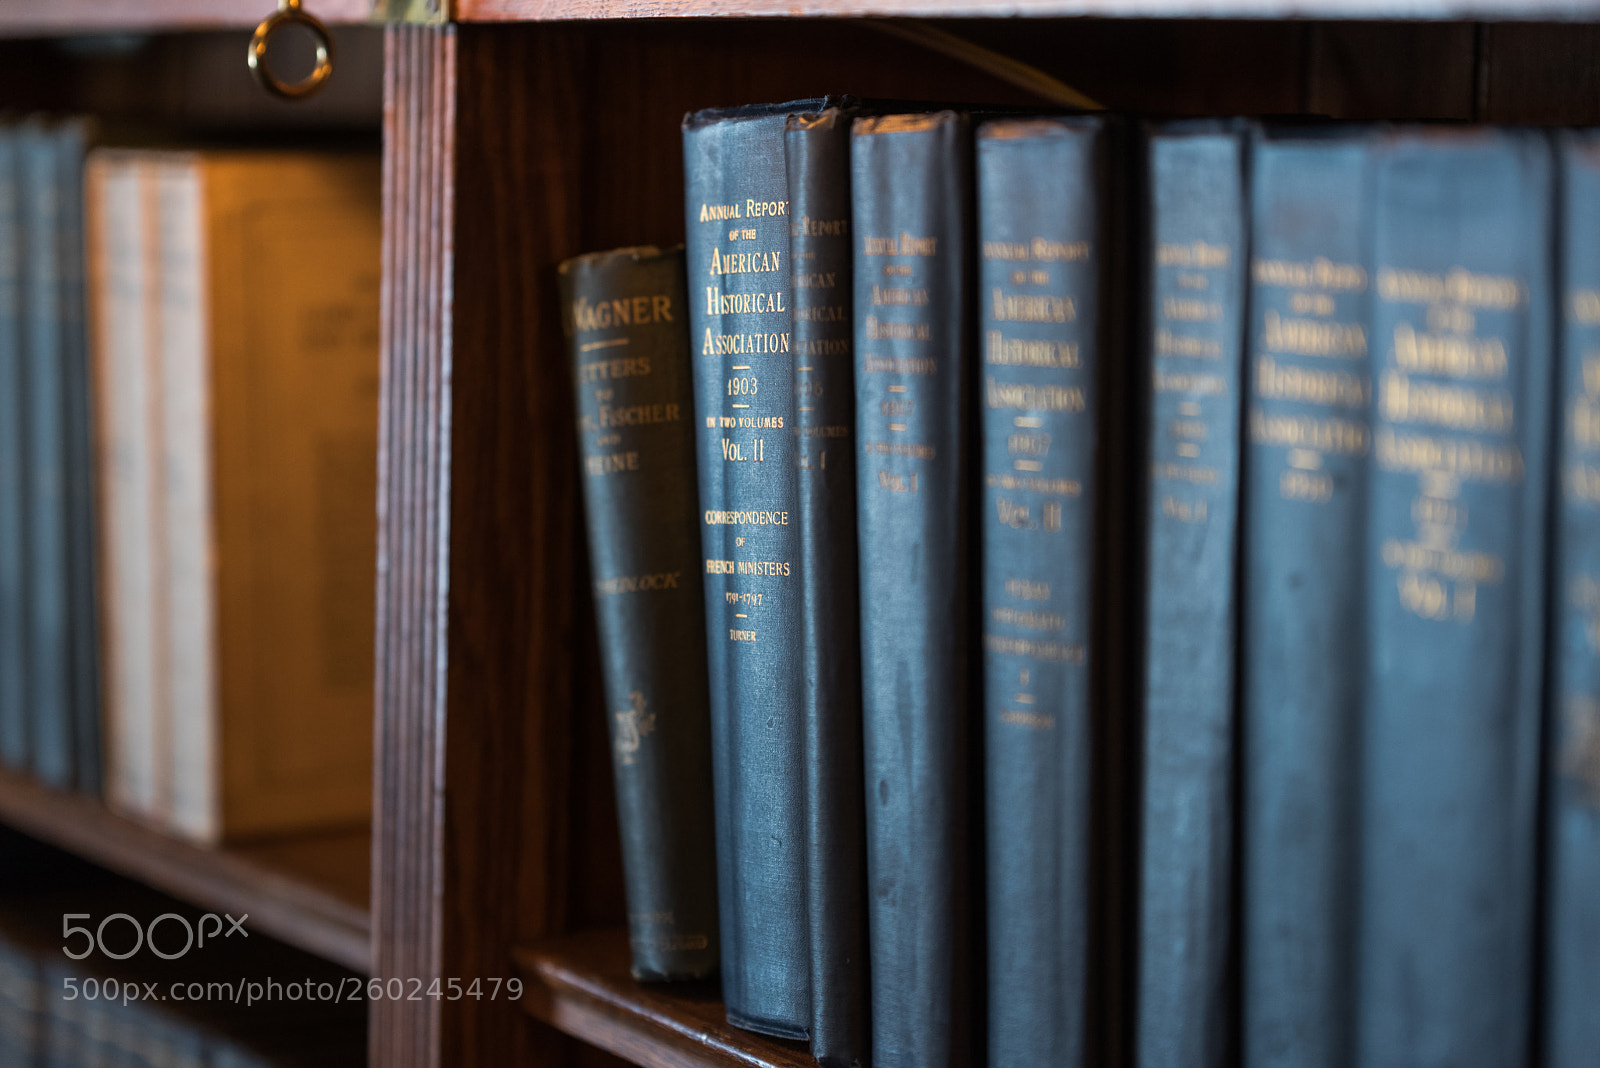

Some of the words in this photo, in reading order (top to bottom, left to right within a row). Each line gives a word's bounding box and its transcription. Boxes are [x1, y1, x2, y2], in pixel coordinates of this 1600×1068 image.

[699, 203, 741, 223] ANNUAL
[728, 230, 739, 242] OF
[741, 228, 757, 241] THE
[709, 247, 781, 276] AMERICAN
[706, 286, 786, 316] HISTORICAL
[702, 327, 790, 356] ASSOCIATION
[727, 377, 758, 396] 1903
[706, 416, 716, 429] IN
[719, 417, 737, 429] TWO
[738, 416, 784, 429] VOLUMES
[753, 438, 764, 462] II
[705, 510, 789, 526] CORRESPONDENCE
[735, 537, 746, 548] OF
[706, 559, 735, 575] FRENCH
[738, 561, 790, 577] MINISTERS
[726, 592, 763, 607] 1791-1797
[729, 629, 757, 642] TURNER
